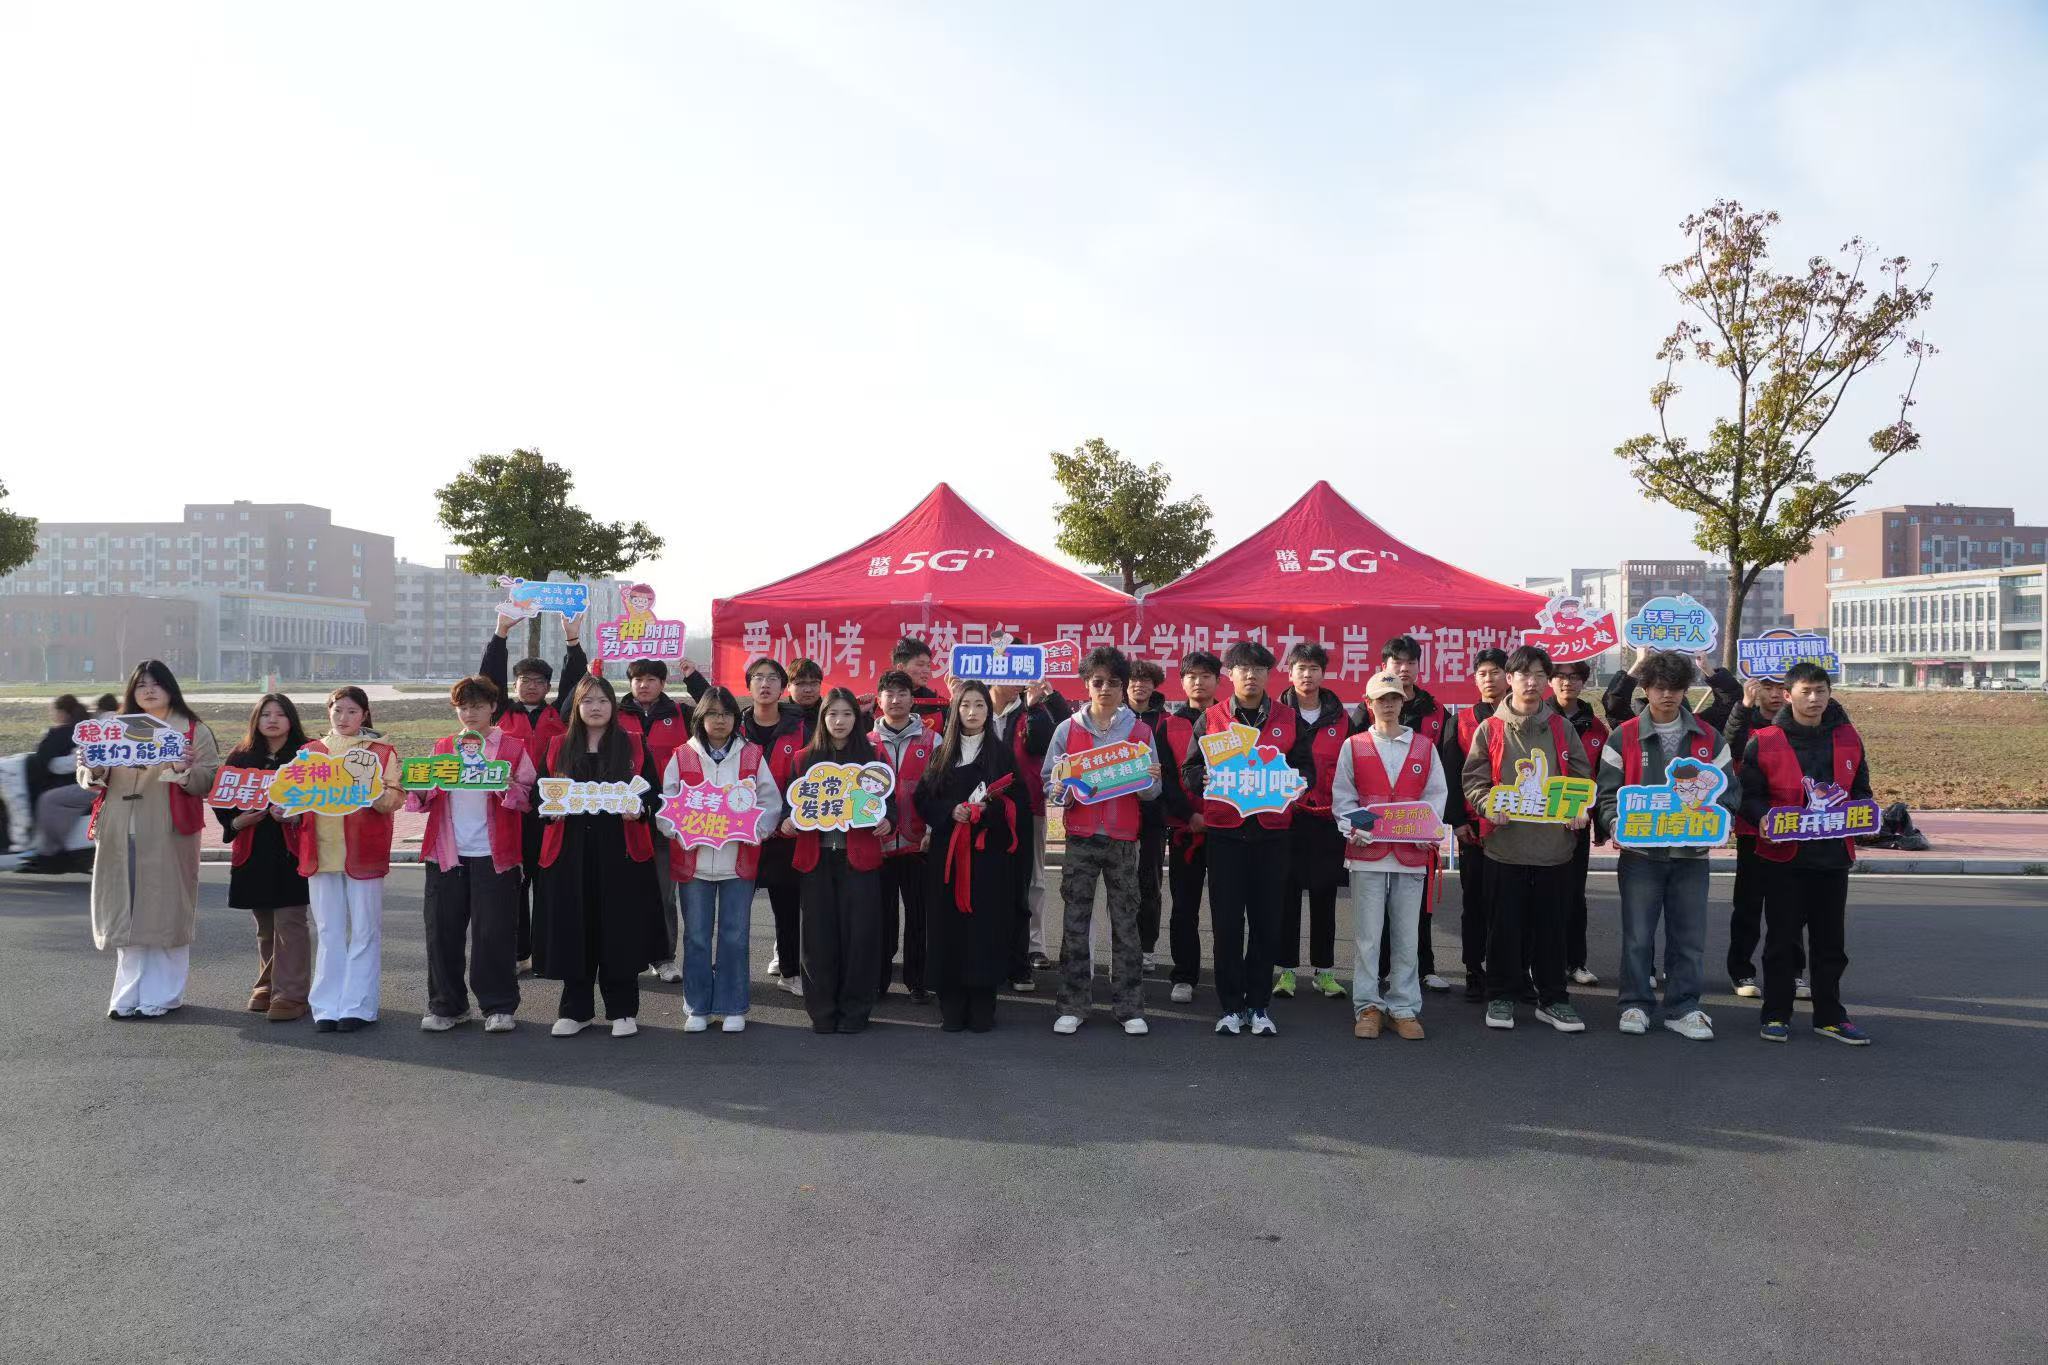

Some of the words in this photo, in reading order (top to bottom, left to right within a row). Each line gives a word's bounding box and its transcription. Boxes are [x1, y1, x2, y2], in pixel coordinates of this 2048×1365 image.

[868, 556, 892, 576] 联通
[1275, 549, 1302, 572] 联通
[1644, 609, 1705, 624] 多考一分
[600, 619, 680, 640] 考神附体
[1741, 640, 1825, 657] 越接近胜利时
[960, 653, 1035, 676] 加油鸭
[78, 723, 122, 742] 稳住
[87, 734, 181, 761] 我们能赢
[1081, 747, 1130, 770] 前程似锦
[407, 760, 503, 784] 逢考必过
[1088, 759, 1148, 784] 顶峰相见
[1208, 766, 1297, 798] 冲刺吧
[283, 784, 370, 807] 全力以赴
[798, 776, 843, 798] 超常
[684, 789, 723, 813] 逢考
[801, 799, 844, 819] 发挥
[1493, 781, 1591, 818] 我能行
[1625, 793, 1672, 811] 你是
[681, 810, 730, 838] 必胜
[1624, 811, 1720, 837] 最棒的
[1773, 805, 1873, 834] 旗开得胜
